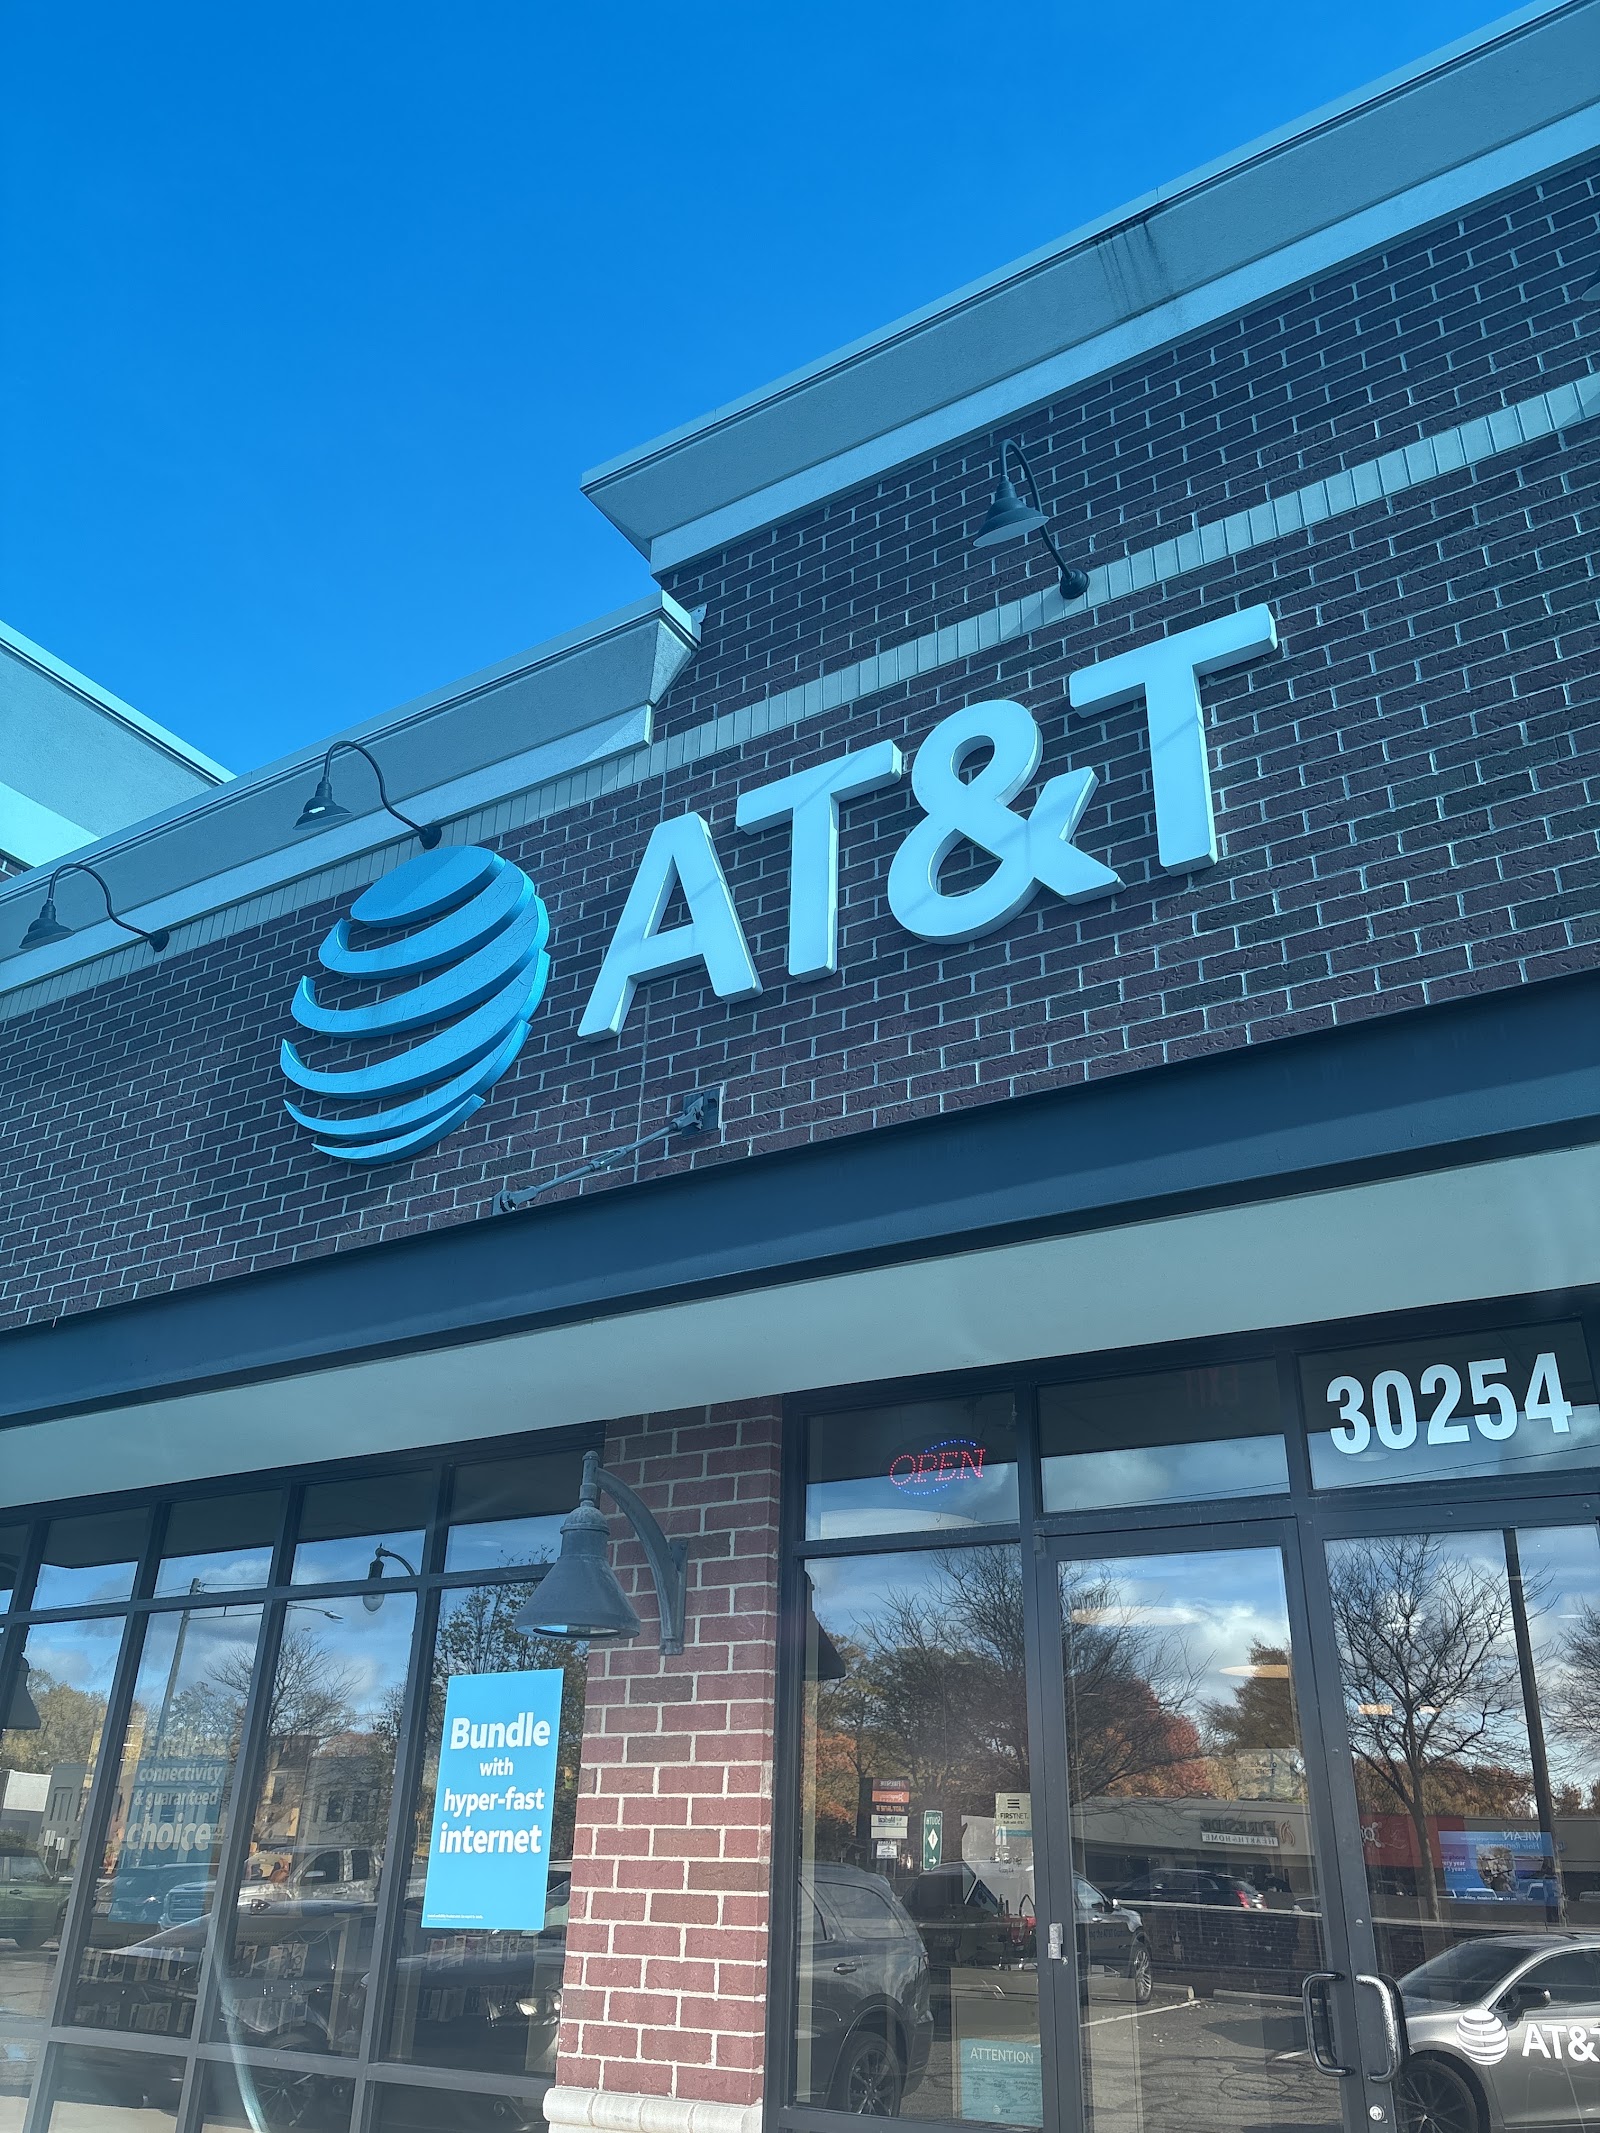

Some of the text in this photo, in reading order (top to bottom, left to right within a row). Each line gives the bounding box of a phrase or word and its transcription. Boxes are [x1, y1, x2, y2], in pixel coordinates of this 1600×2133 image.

[577, 605, 1278, 1042] AT&T
[1326, 1352, 1574, 1454] 30254
[889, 1448, 986, 1486] OPEN
[450, 1711, 551, 1750] Bundle
[138, 1763, 223, 1785] connectivity
[479, 1757, 514, 1776] with
[133, 1788, 220, 1810] & guaranteed
[443, 1786, 545, 1818] hyper-fast
[126, 1812, 212, 1851] choice
[438, 1822, 543, 1855] internet
[970, 2047, 1034, 2064] ATTENTION
